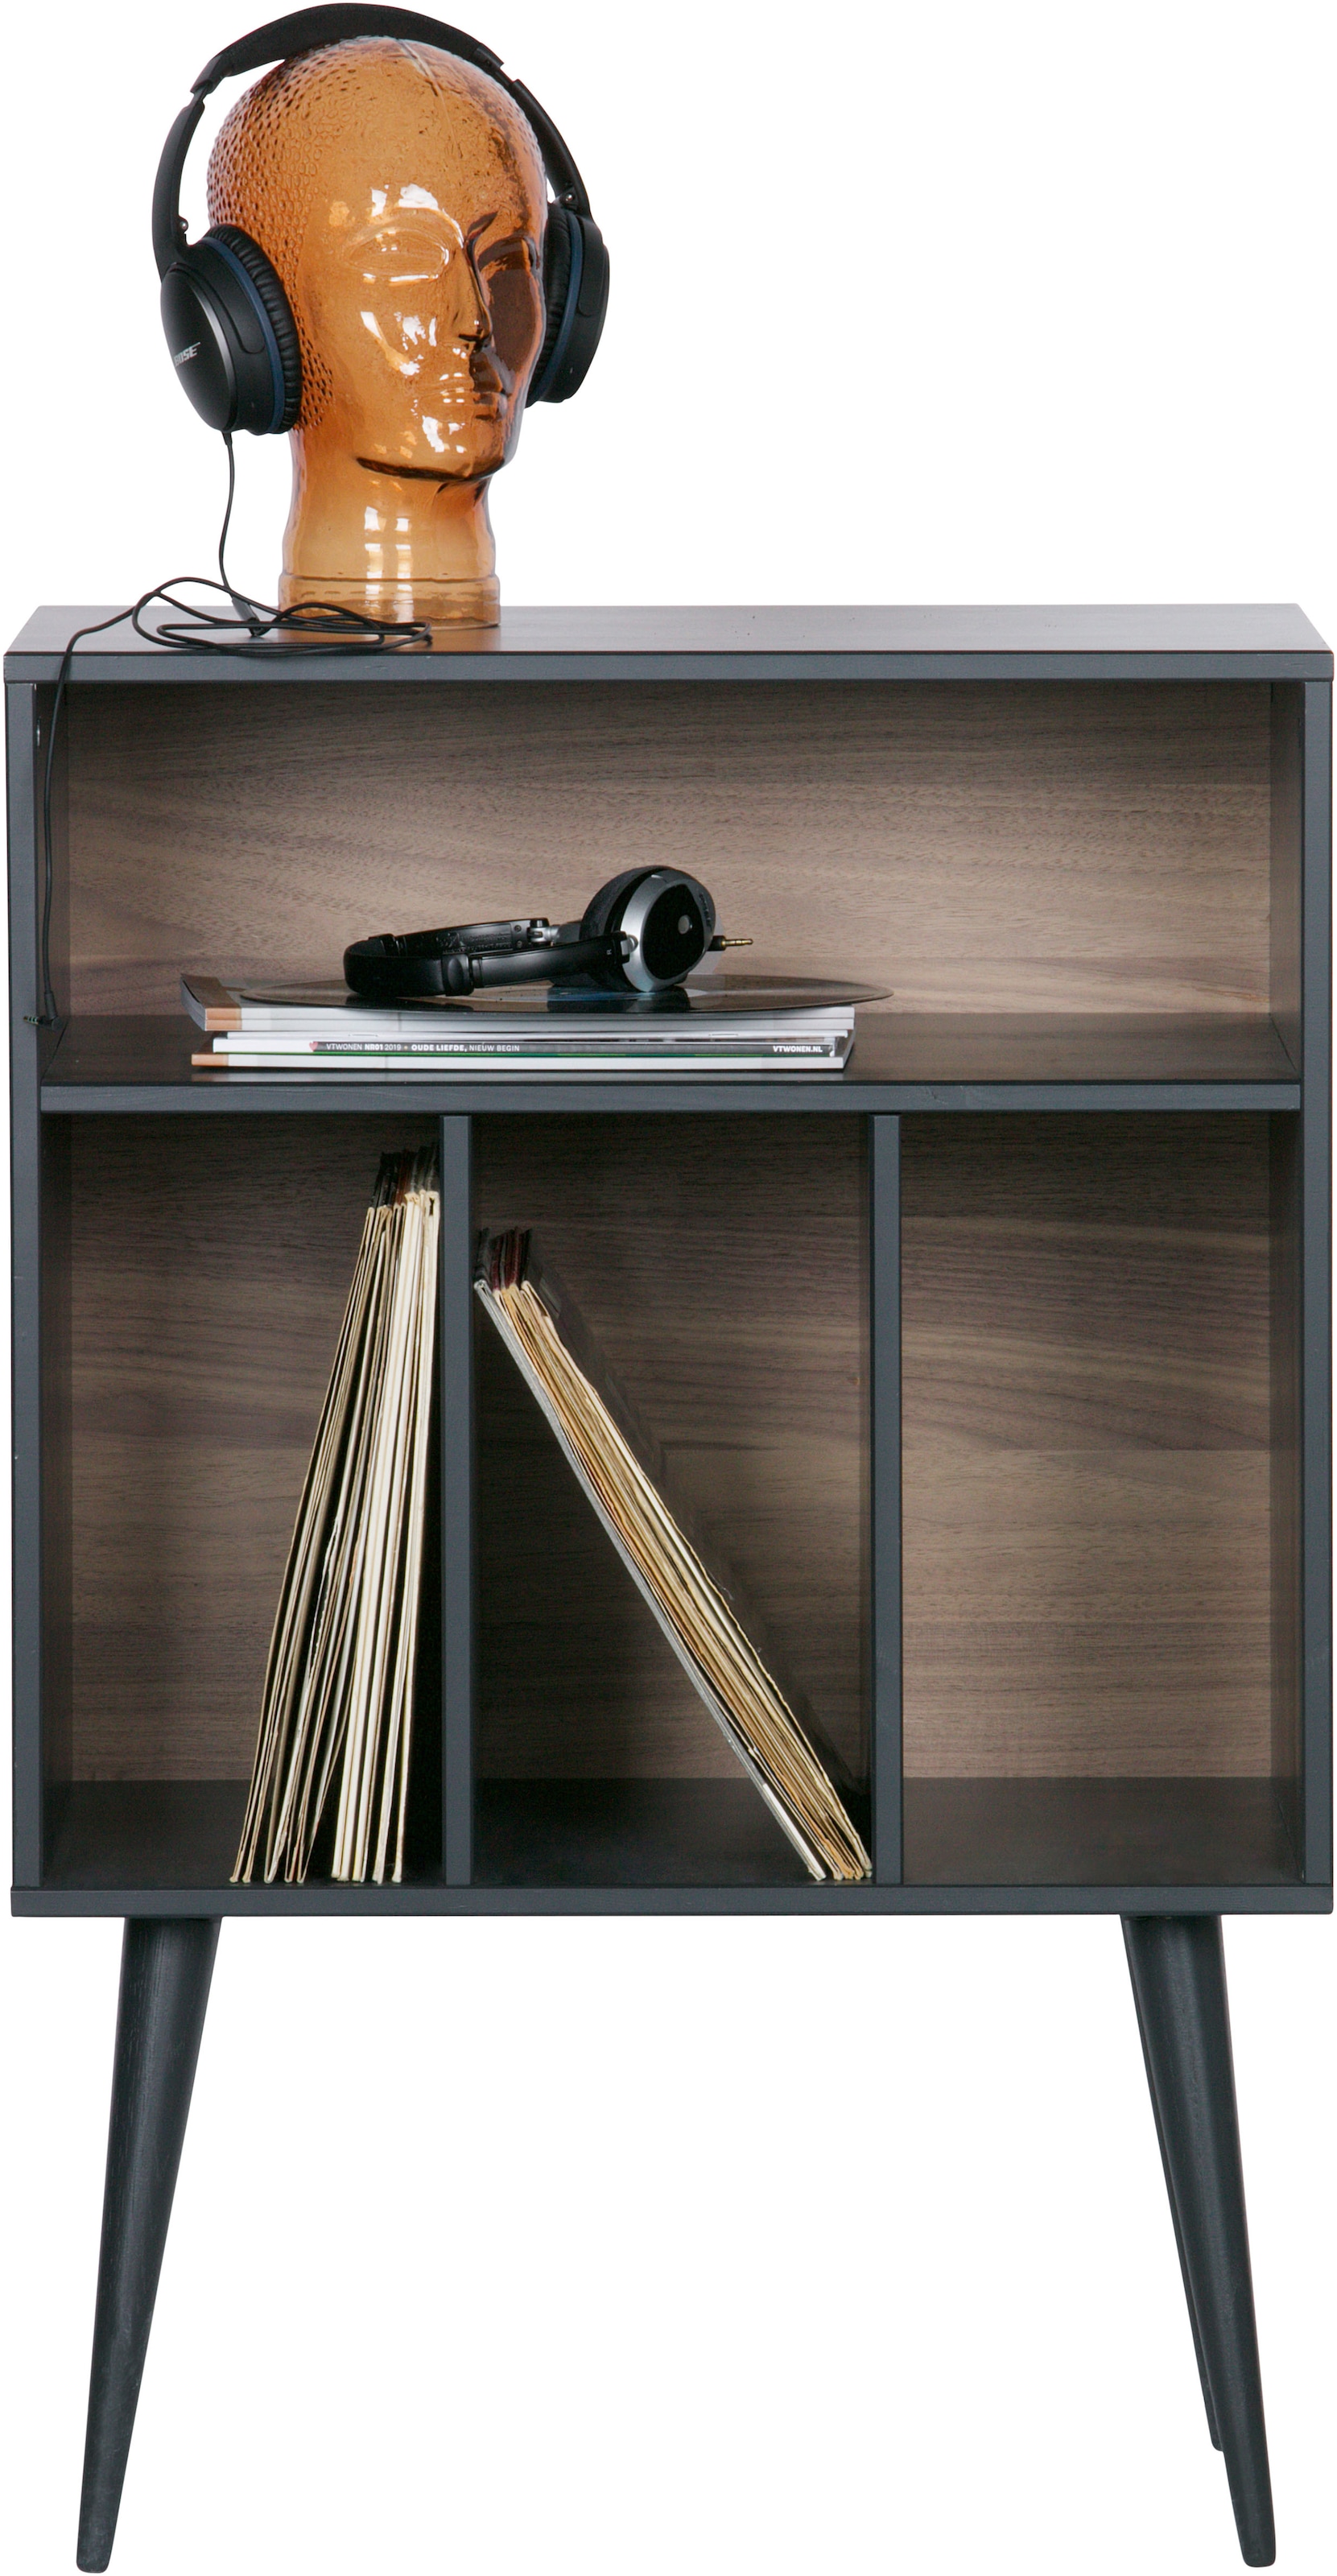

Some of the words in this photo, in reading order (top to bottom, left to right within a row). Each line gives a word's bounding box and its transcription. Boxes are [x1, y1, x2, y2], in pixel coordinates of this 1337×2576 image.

[174, 341, 201, 367] BOSE
[384, 1043, 402, 1051] 2019
[435, 1044, 467, 1052] LIEFDE,
[496, 1044, 520, 1052] BEGIN
[773, 1045, 823, 1053] VTWONEN.NL
